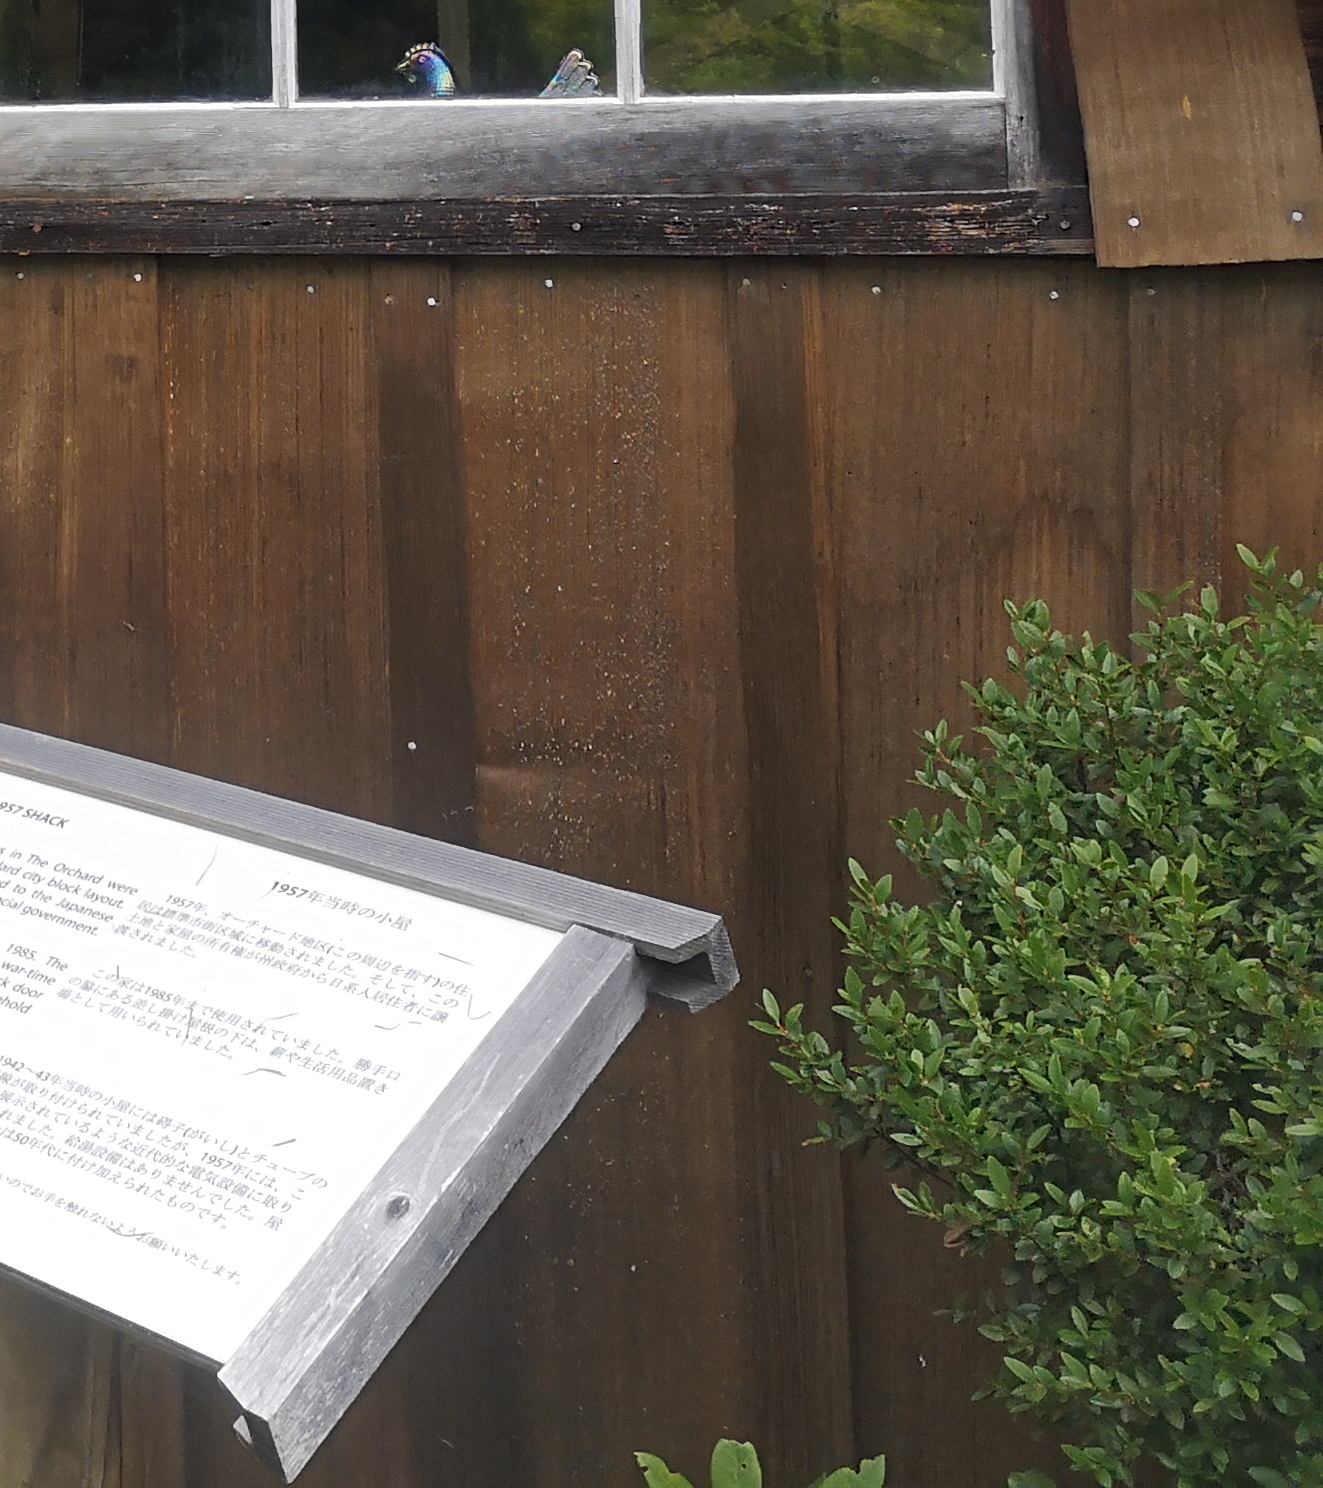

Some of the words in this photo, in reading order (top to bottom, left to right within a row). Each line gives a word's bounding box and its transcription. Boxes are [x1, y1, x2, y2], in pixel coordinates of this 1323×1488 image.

[21, 808, 69, 828] SHACK
[8, 849, 22, 859] in
[26, 853, 49, 867] The
[52, 862, 104, 884] Orchard
[106, 880, 138, 895] were
[12, 883, 27, 894] to
[30, 889, 52, 902] the
[54, 897, 113, 922] Japanese
[21, 871, 46, 884] city
[46, 876, 81, 895] block
[82, 887, 124, 909] layout.
[269, 880, 412, 930] 1957年当時の小屋
[19, 905, 98, 936] government.
[114, 924, 195, 956] 渡されました。
[5, 943, 37, 961] 1985.
[45, 955, 68, 971] The
[0, 961, 56, 985] war-time
[11, 982, 44, 999] door
